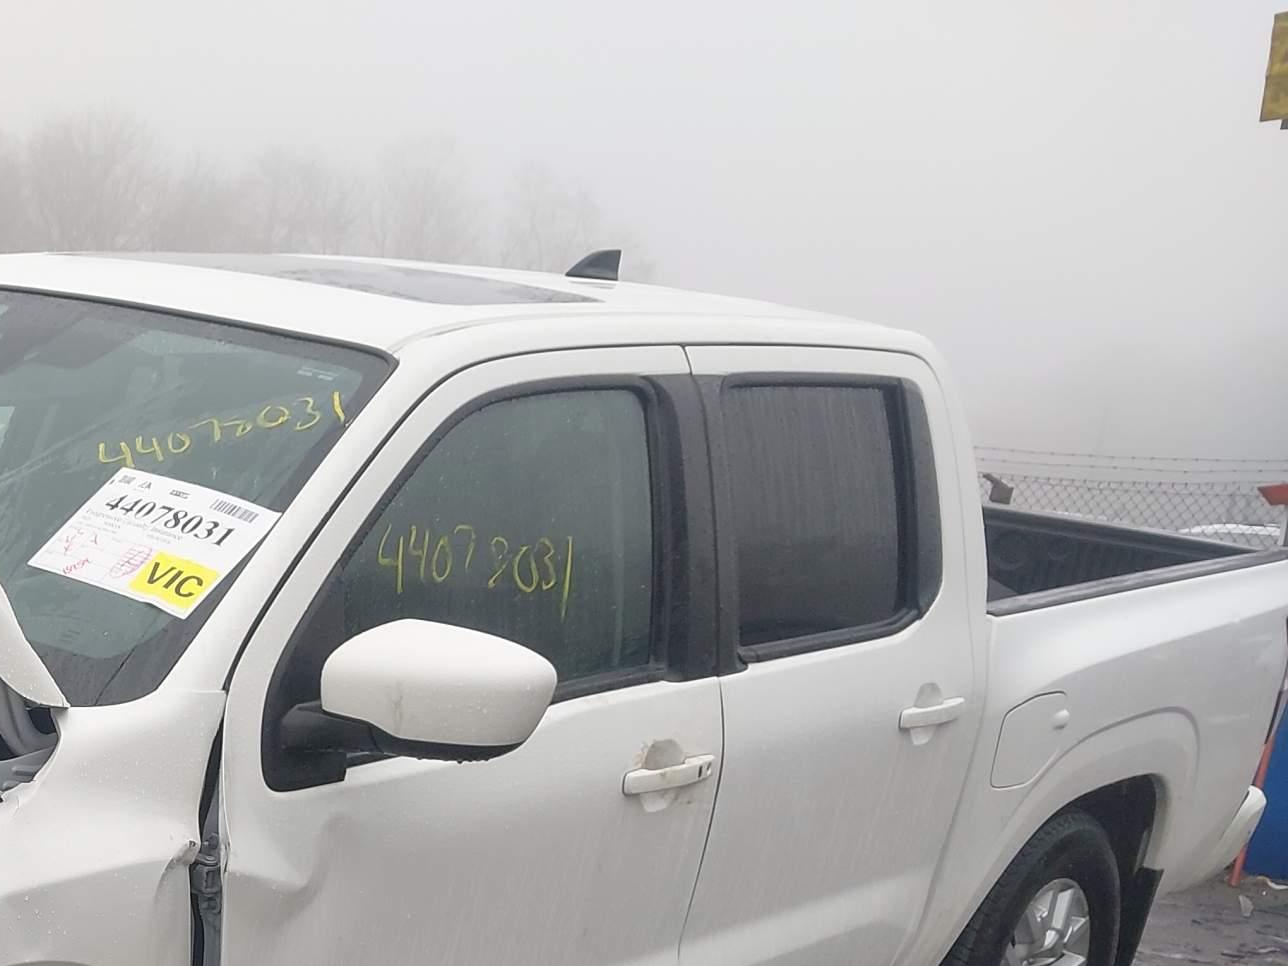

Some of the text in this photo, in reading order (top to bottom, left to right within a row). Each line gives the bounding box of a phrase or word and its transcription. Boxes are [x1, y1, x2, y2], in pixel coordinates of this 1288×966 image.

[105, 494, 236, 548] 44078031
[146, 561, 204, 599] VIC
[377, 523, 574, 623] 44078031
